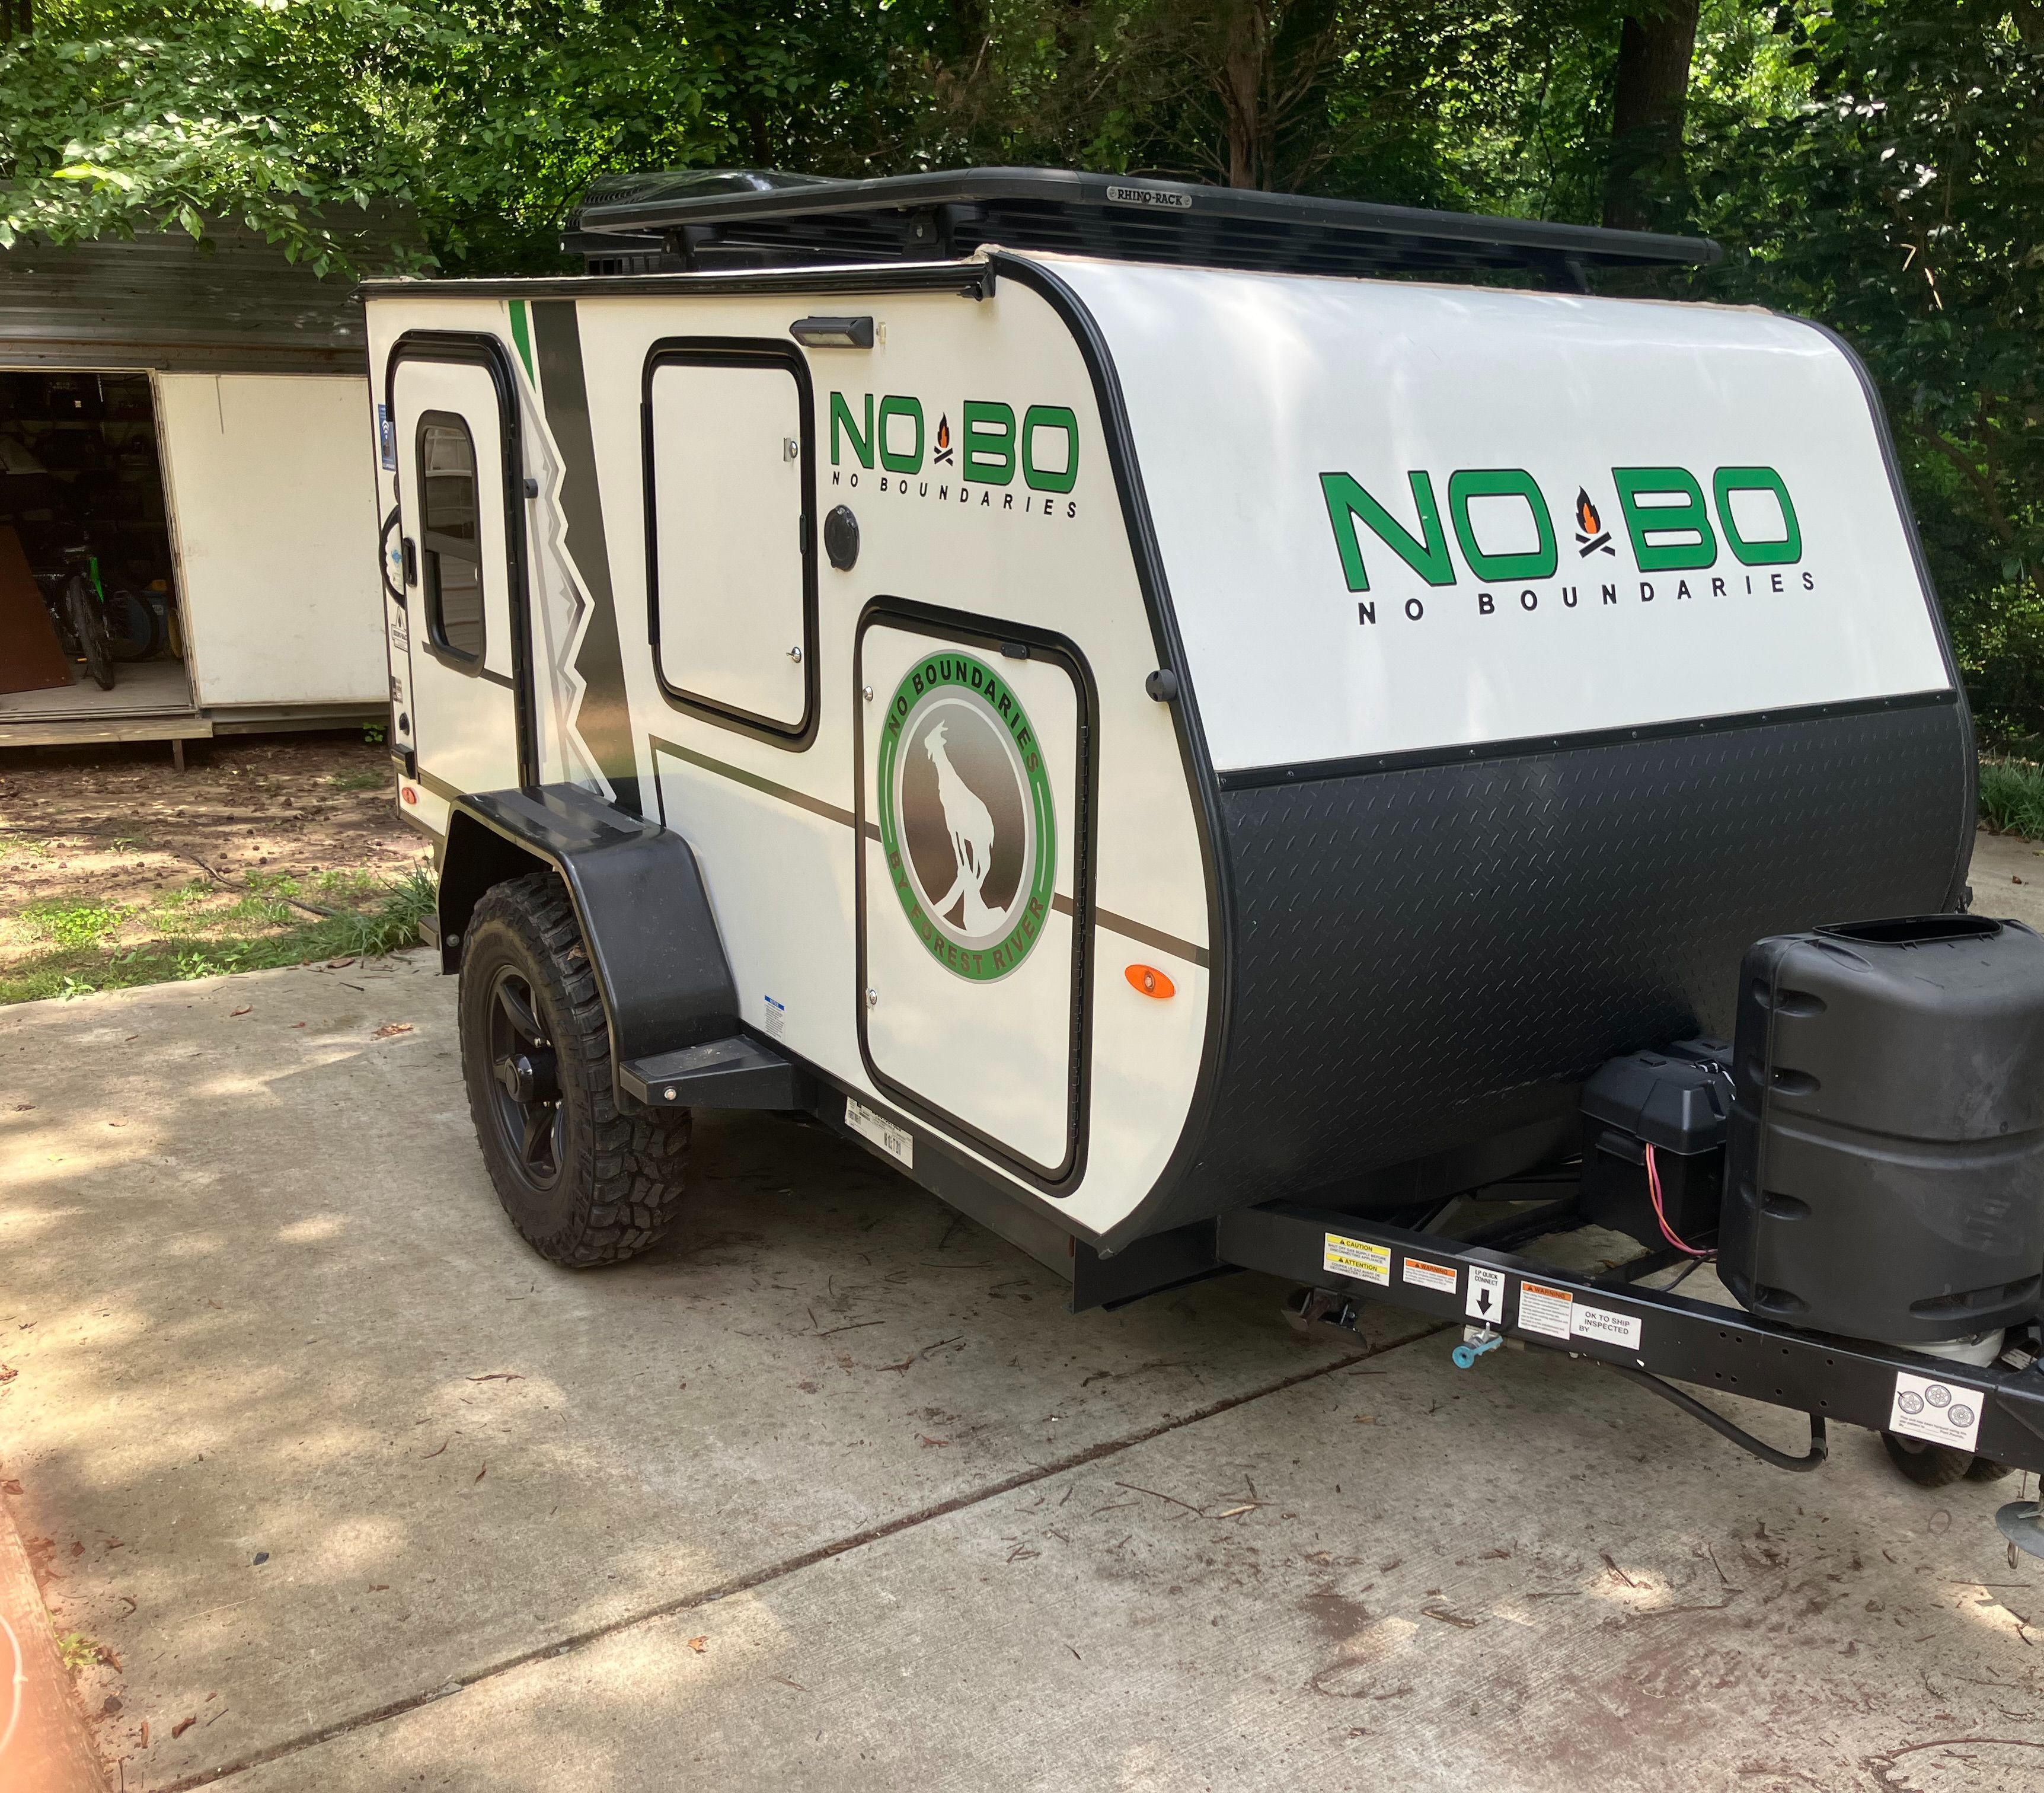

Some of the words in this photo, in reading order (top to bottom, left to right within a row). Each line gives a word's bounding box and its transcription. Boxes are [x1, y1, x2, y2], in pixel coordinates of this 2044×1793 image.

[1117, 189, 1183, 206] RHINO-RACK
[830, 391, 925, 476] NO
[963, 400, 1080, 494] BO
[832, 471, 859, 488] NO
[880, 477, 1077, 519] BOUNDARIES
[1319, 469, 1558, 593] NO
[1611, 466, 1803, 573] BO
[1359, 597, 1424, 626] NO
[1478, 571, 1816, 615] BOUNDARIES
[888, 695, 909, 739] NO
[912, 659, 1040, 773] BOUNDARIES
[889, 849, 909, 890] BY
[910, 902, 983, 975] FOREST
[992, 895, 1045, 972] RIVER
[1346, 1240, 1373, 1252] CAUTION
[1345, 1259, 1378, 1271] ATTENTION
[1421, 1264, 1448, 1275] WARNING
[1474, 1275, 1499, 1286] CONNECT
[1482, 1271, 1498, 1280] QUICK
[1534, 1287, 1566, 1299] WARNING
[1584, 1318, 1629, 1335] INSPECTED
[1585, 1311, 1597, 1320] OK
[1598, 1314, 1610, 1323] TO
[1611, 1317, 1630, 1327] SHIP
[1579, 1324, 1590, 1333] BY
